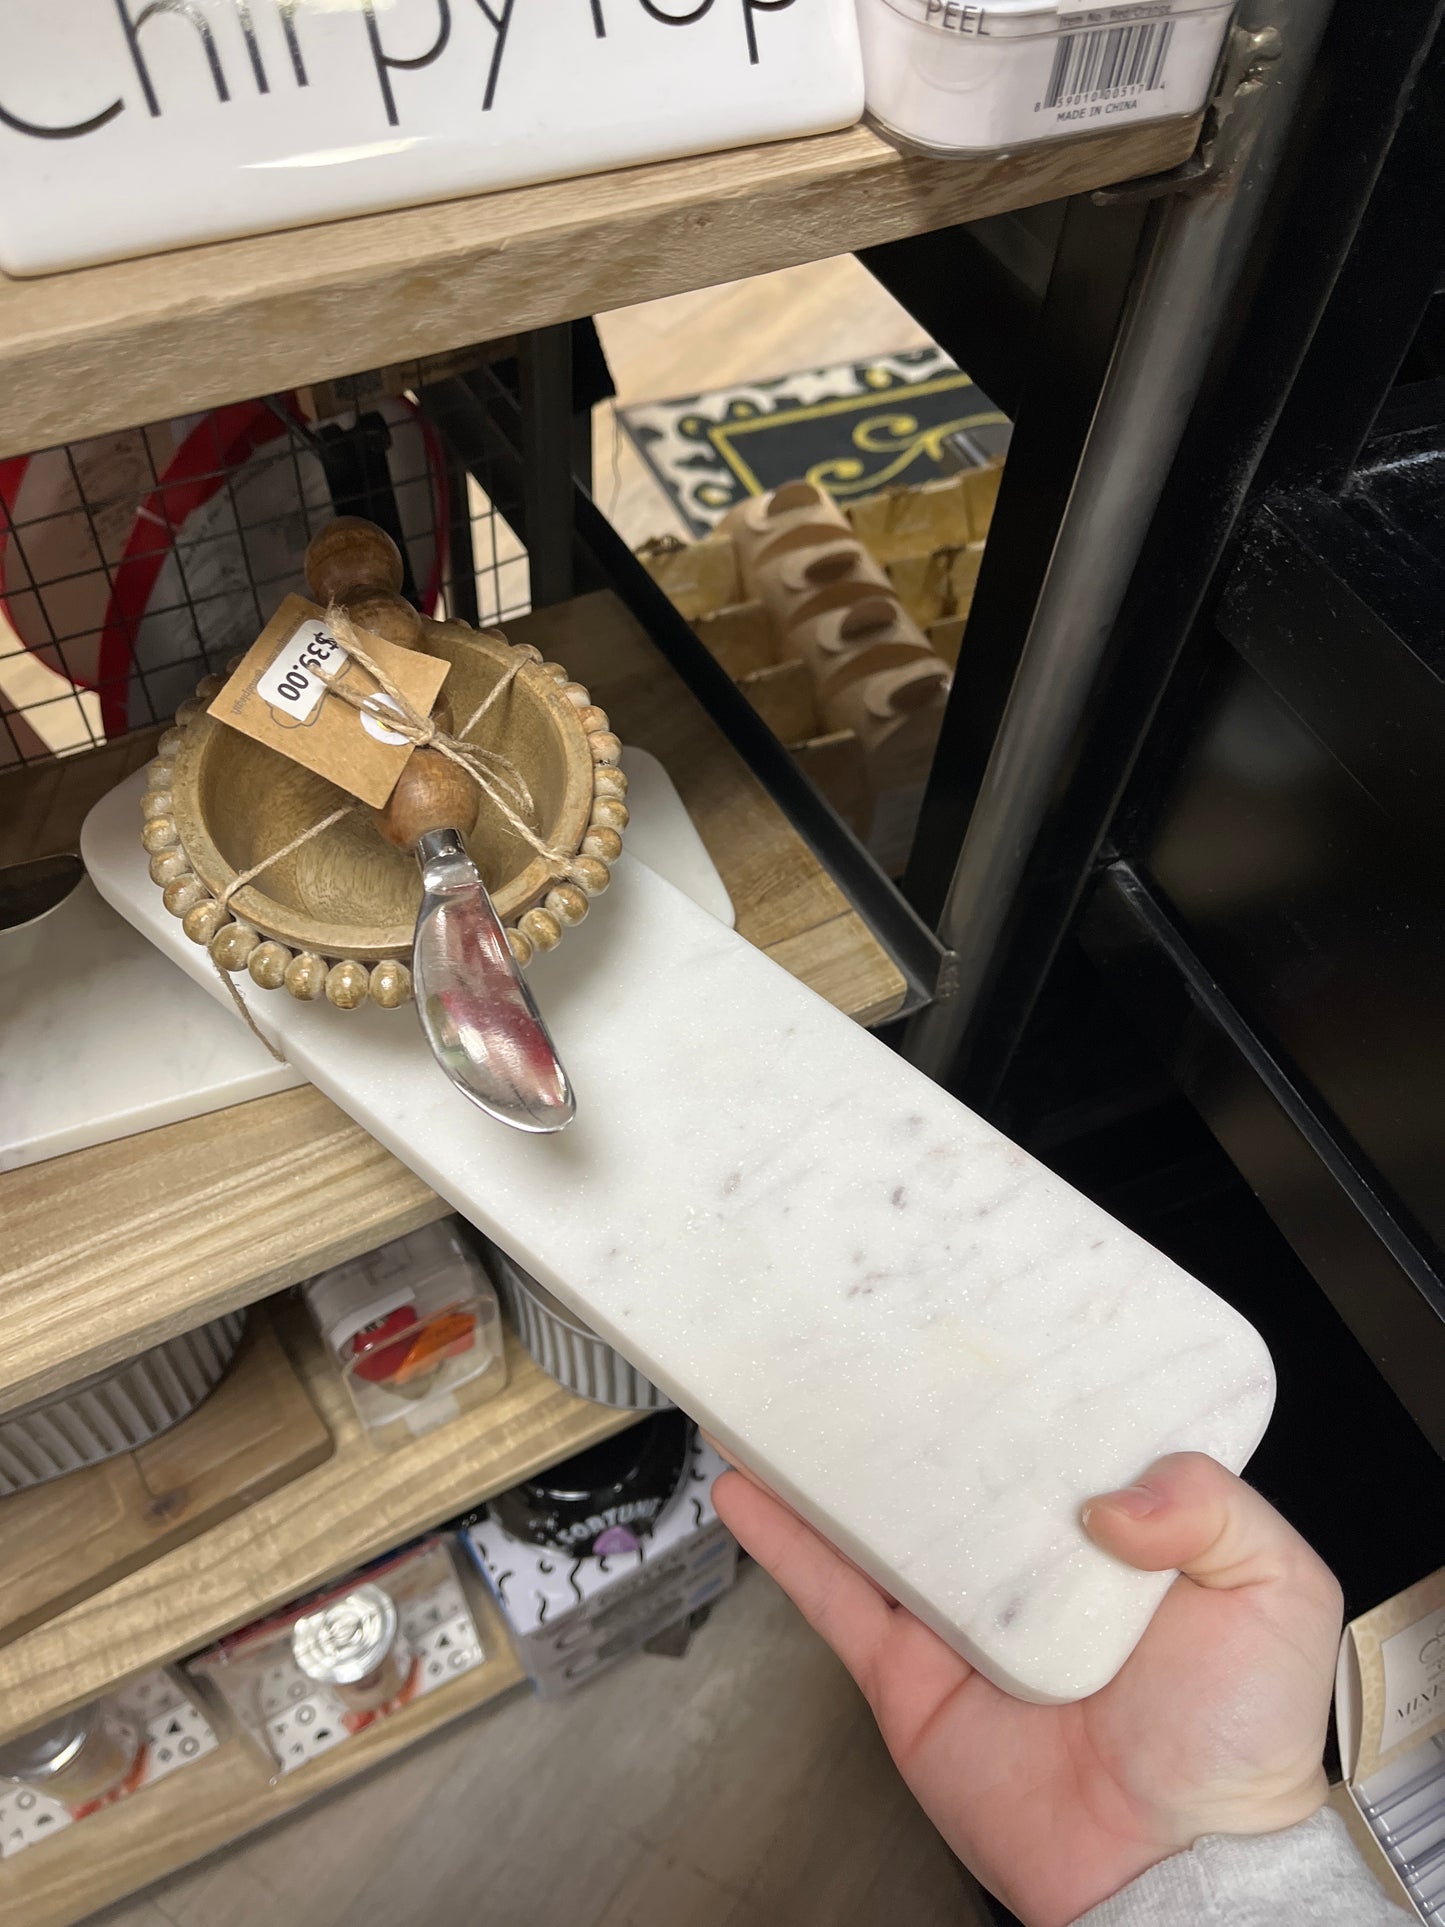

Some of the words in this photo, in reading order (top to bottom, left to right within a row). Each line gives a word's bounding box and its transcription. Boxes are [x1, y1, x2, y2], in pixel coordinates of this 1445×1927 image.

[926, 0, 991, 36] PEEL
[0, 0, 516, 140] hirpy
[1056, 107, 1087, 122] MADE
[1088, 105, 1102, 118] IN
[1104, 99, 1138, 115] CHINA
[276, 631, 340, 702] $39.00
